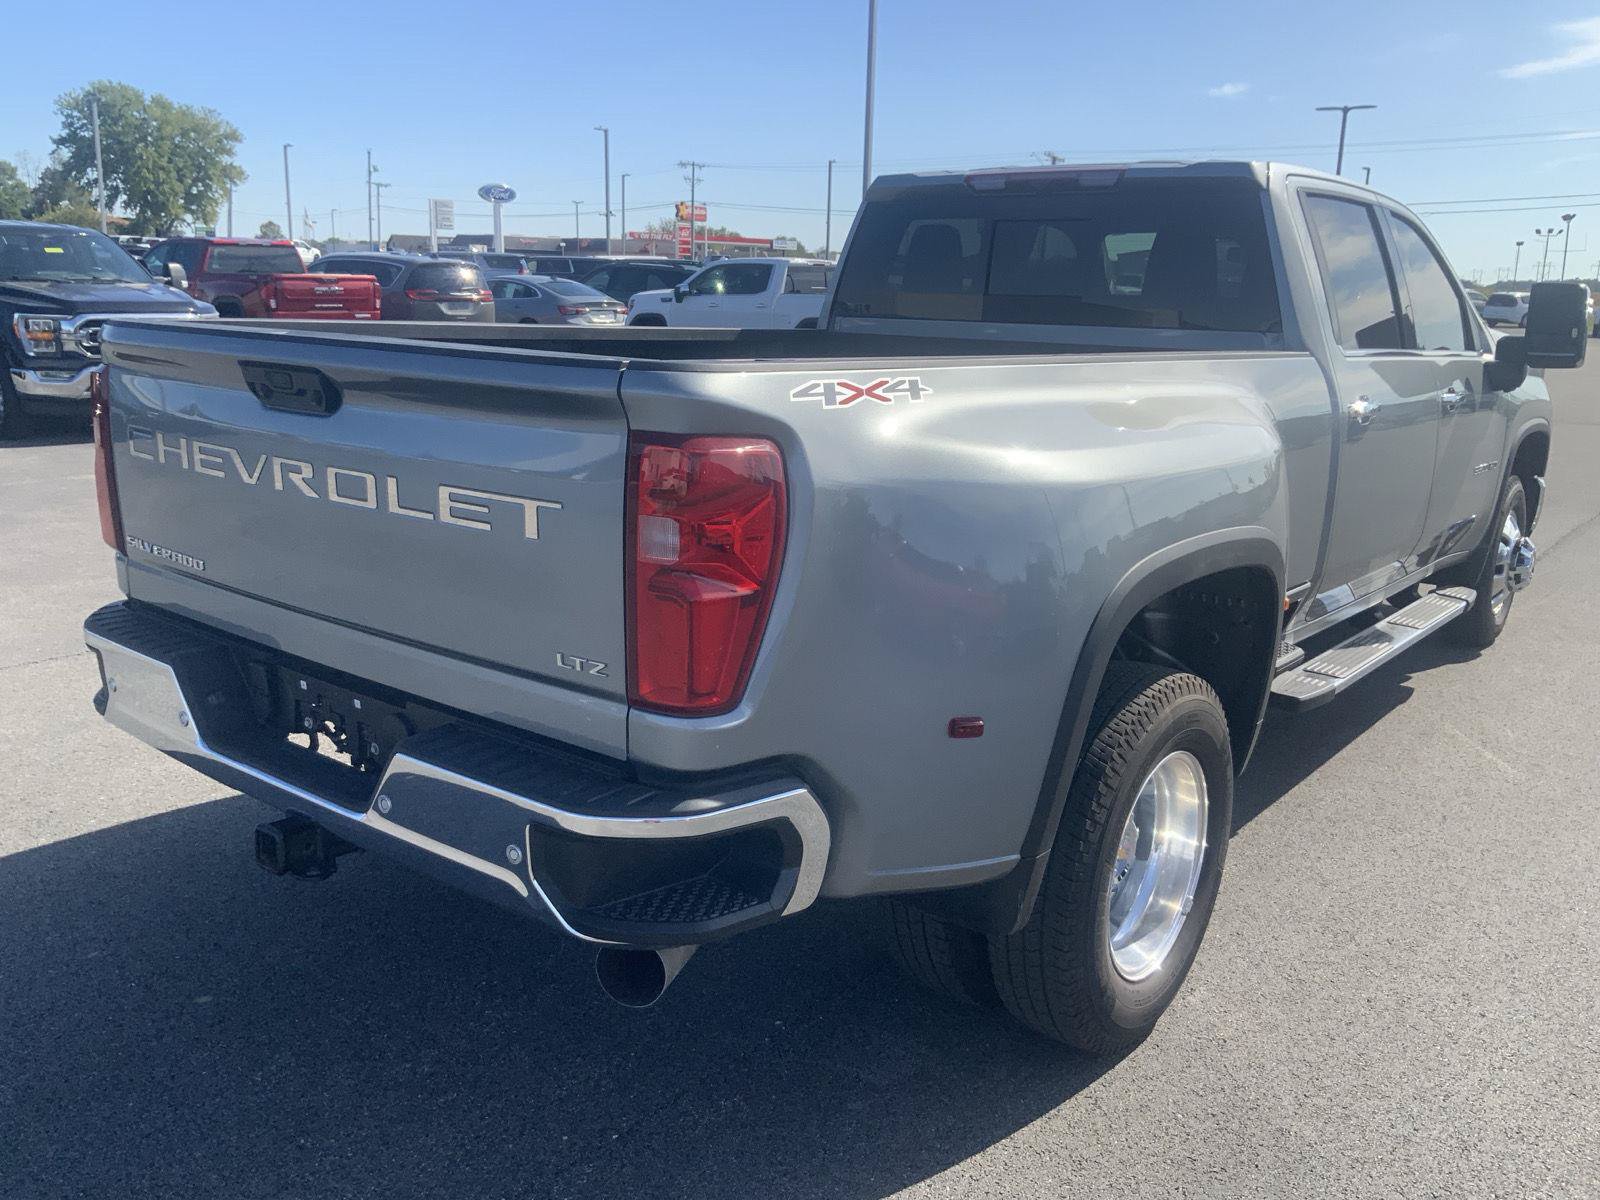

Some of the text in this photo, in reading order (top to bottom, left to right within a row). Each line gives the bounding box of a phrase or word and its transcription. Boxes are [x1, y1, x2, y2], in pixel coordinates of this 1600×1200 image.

[127, 425, 563, 540] CHEVROLET
[126, 534, 206, 571] SILVERADO
[556, 652, 609, 678] LTZ
